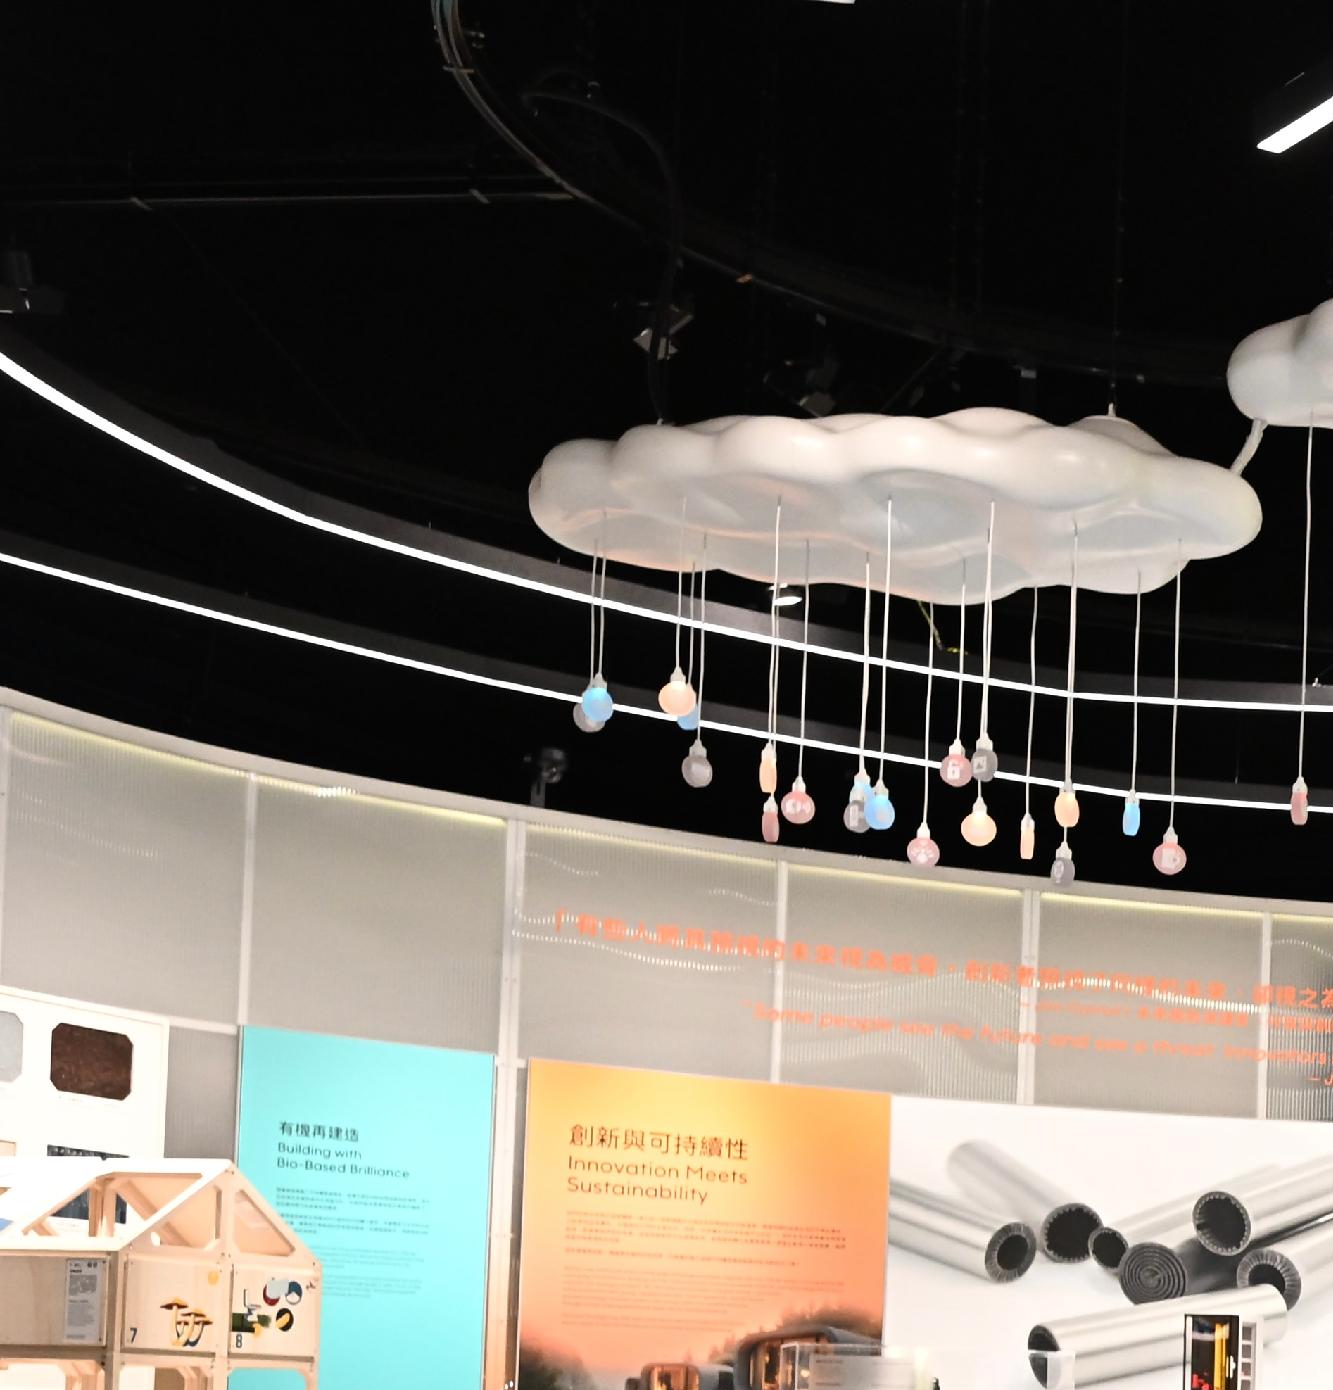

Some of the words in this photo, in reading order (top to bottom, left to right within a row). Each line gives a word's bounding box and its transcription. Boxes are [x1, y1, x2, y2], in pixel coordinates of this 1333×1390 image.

[278, 1141, 331, 1160] Building
[335, 1148, 362, 1160] with
[568, 1123, 749, 1161] 創新與可持續性
[276, 1157, 346, 1174] Bio-Based
[350, 1164, 410, 1179] Brilliance
[568, 1155, 679, 1179] Innovation
[686, 1164, 749, 1185] Meets
[567, 1176, 708, 1205] Sustainability
[129, 1327, 138, 1344] 7
[235, 1333, 243, 1349] 8
